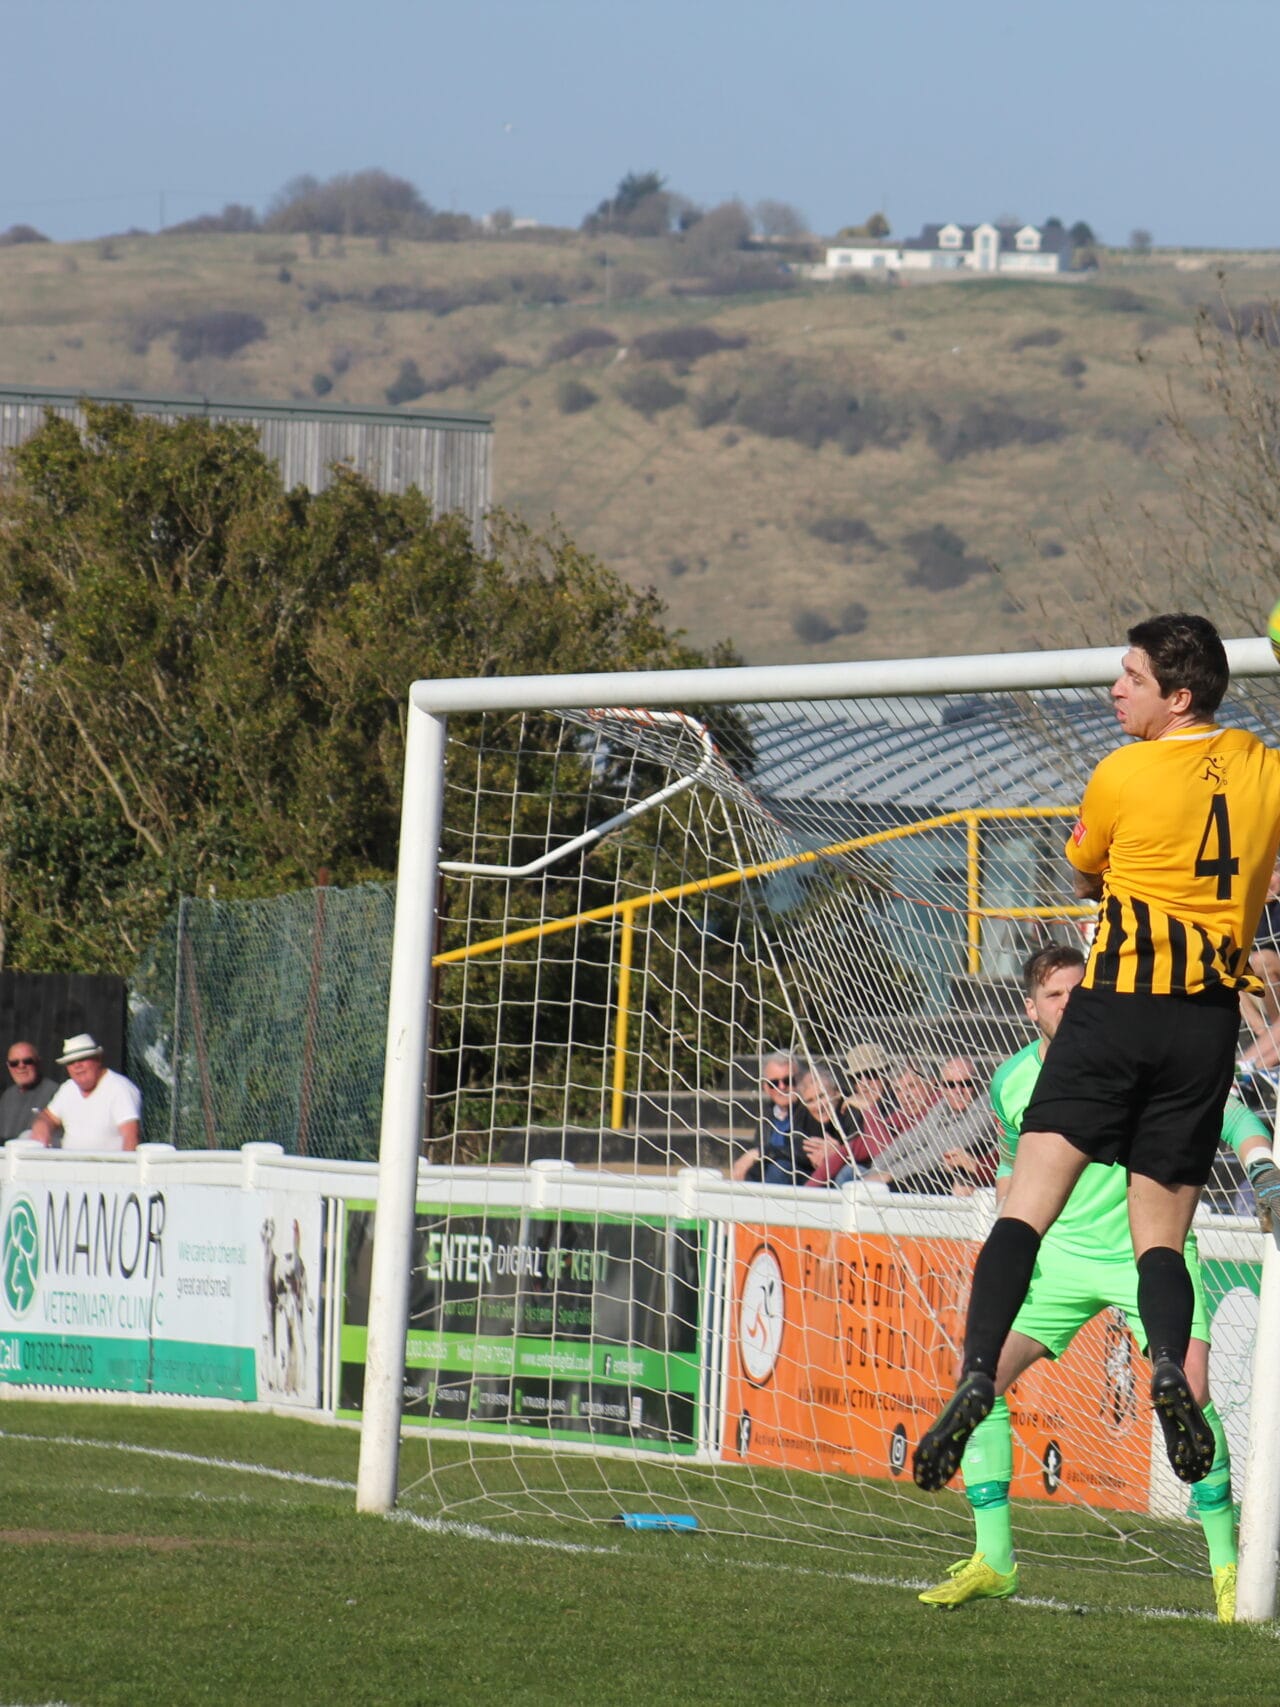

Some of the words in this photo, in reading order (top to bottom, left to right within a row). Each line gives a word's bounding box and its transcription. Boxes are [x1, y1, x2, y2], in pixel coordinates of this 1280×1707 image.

[1195, 793, 1240, 900] 4
[45, 1190, 167, 1280] MANOR
[427, 1232, 493, 1283] ENTER
[497, 1244, 542, 1278] DIGITAL
[43, 1291, 115, 1327] VETERINARY
[118, 1292, 165, 1330] CLINIC
[0, 1338, 21, 1370] Call
